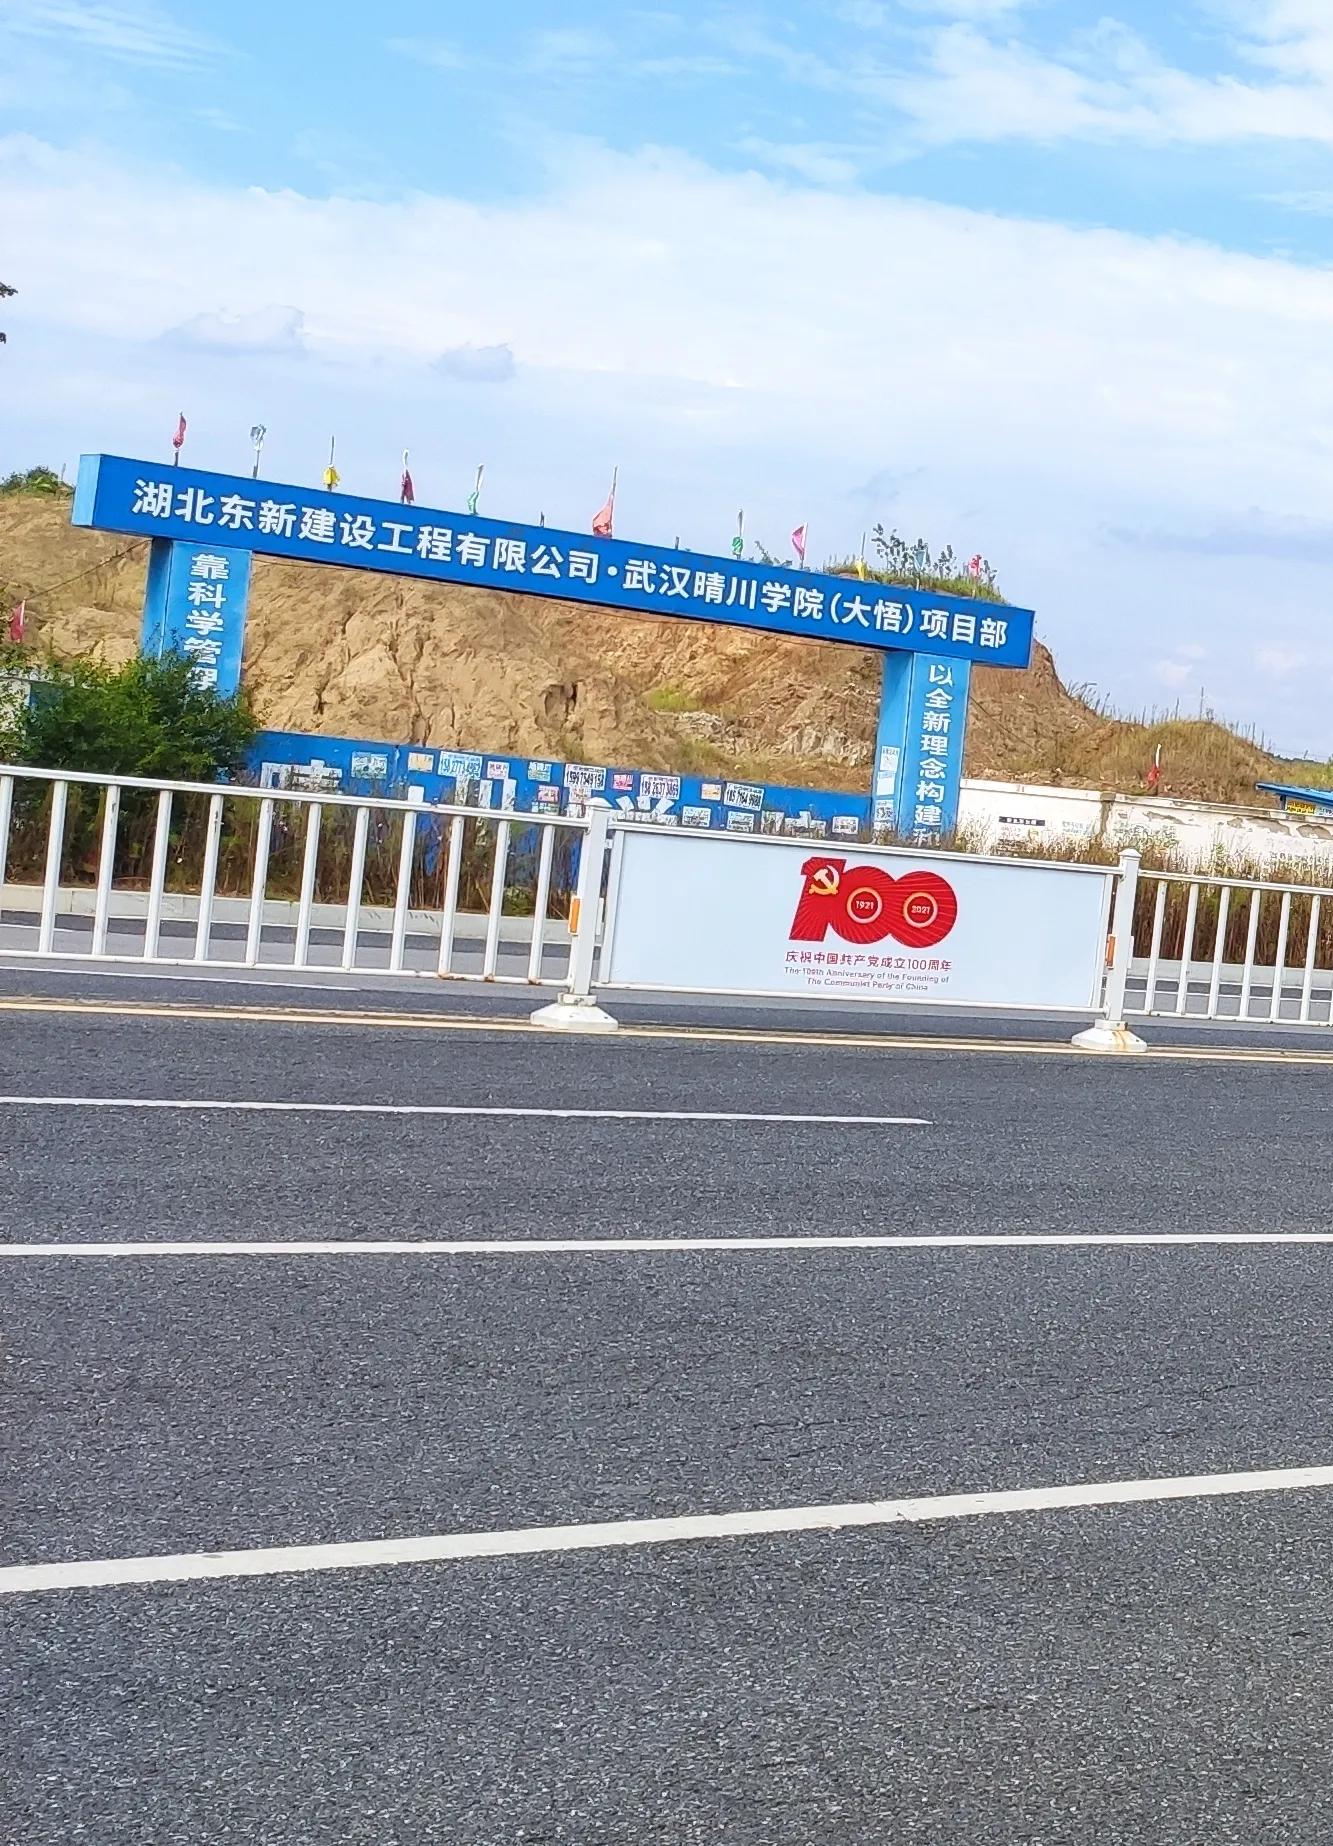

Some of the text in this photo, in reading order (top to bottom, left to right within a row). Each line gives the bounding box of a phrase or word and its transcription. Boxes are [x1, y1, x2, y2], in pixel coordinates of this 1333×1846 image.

[855, 900, 874, 910] 1921
[911, 904, 931, 915] 2021
[785, 951, 952, 972] 庆祝中国共产党成立100周年
[784, 966, 802, 975] The
[827, 969, 875, 980] Anniversary
